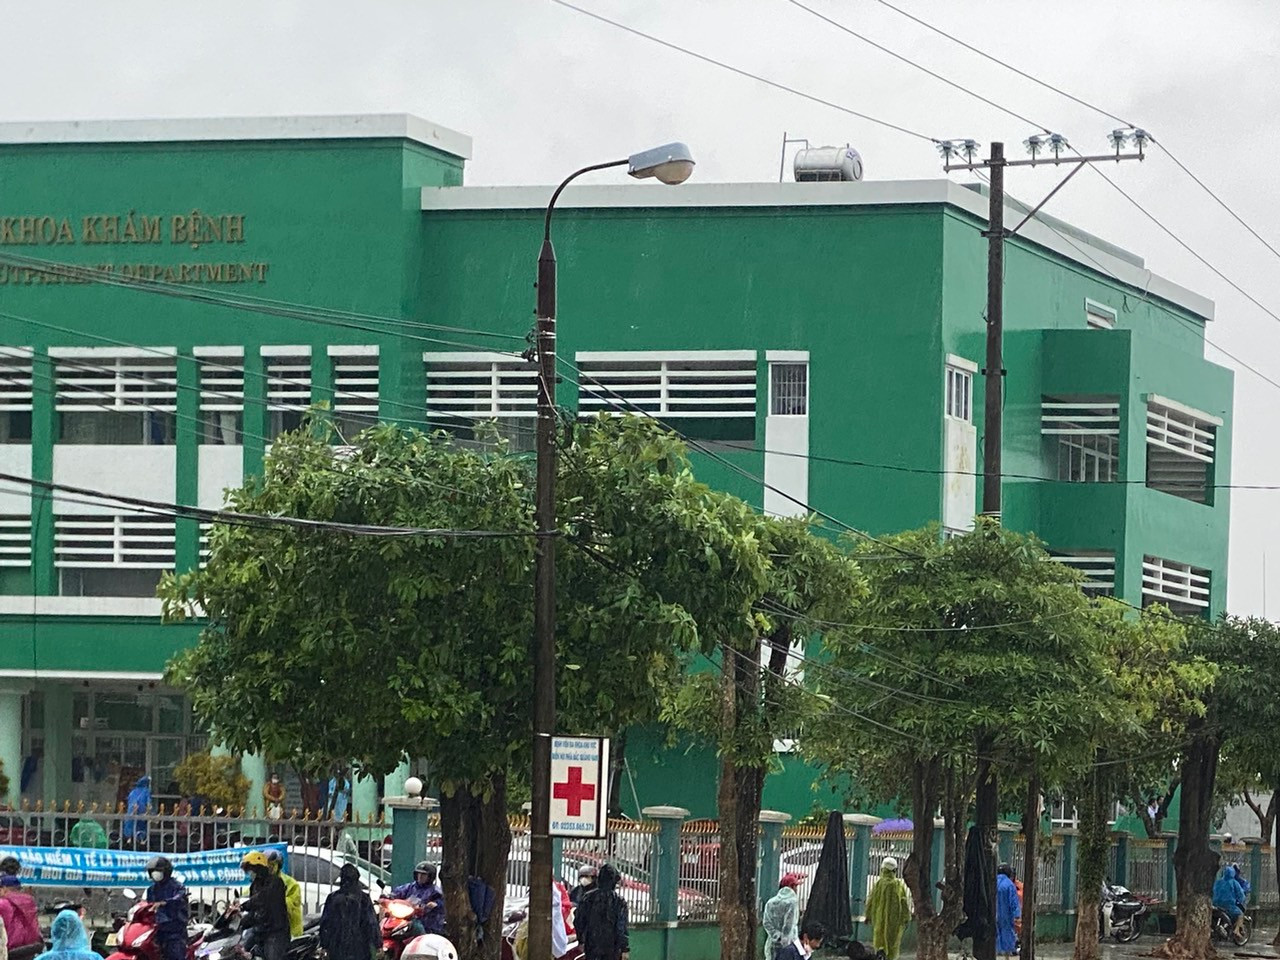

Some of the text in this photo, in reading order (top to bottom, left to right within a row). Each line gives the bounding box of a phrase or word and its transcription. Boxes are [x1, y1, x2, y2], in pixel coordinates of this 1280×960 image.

[0, 208, 246, 249] KHOA KHÁM BỆNH
